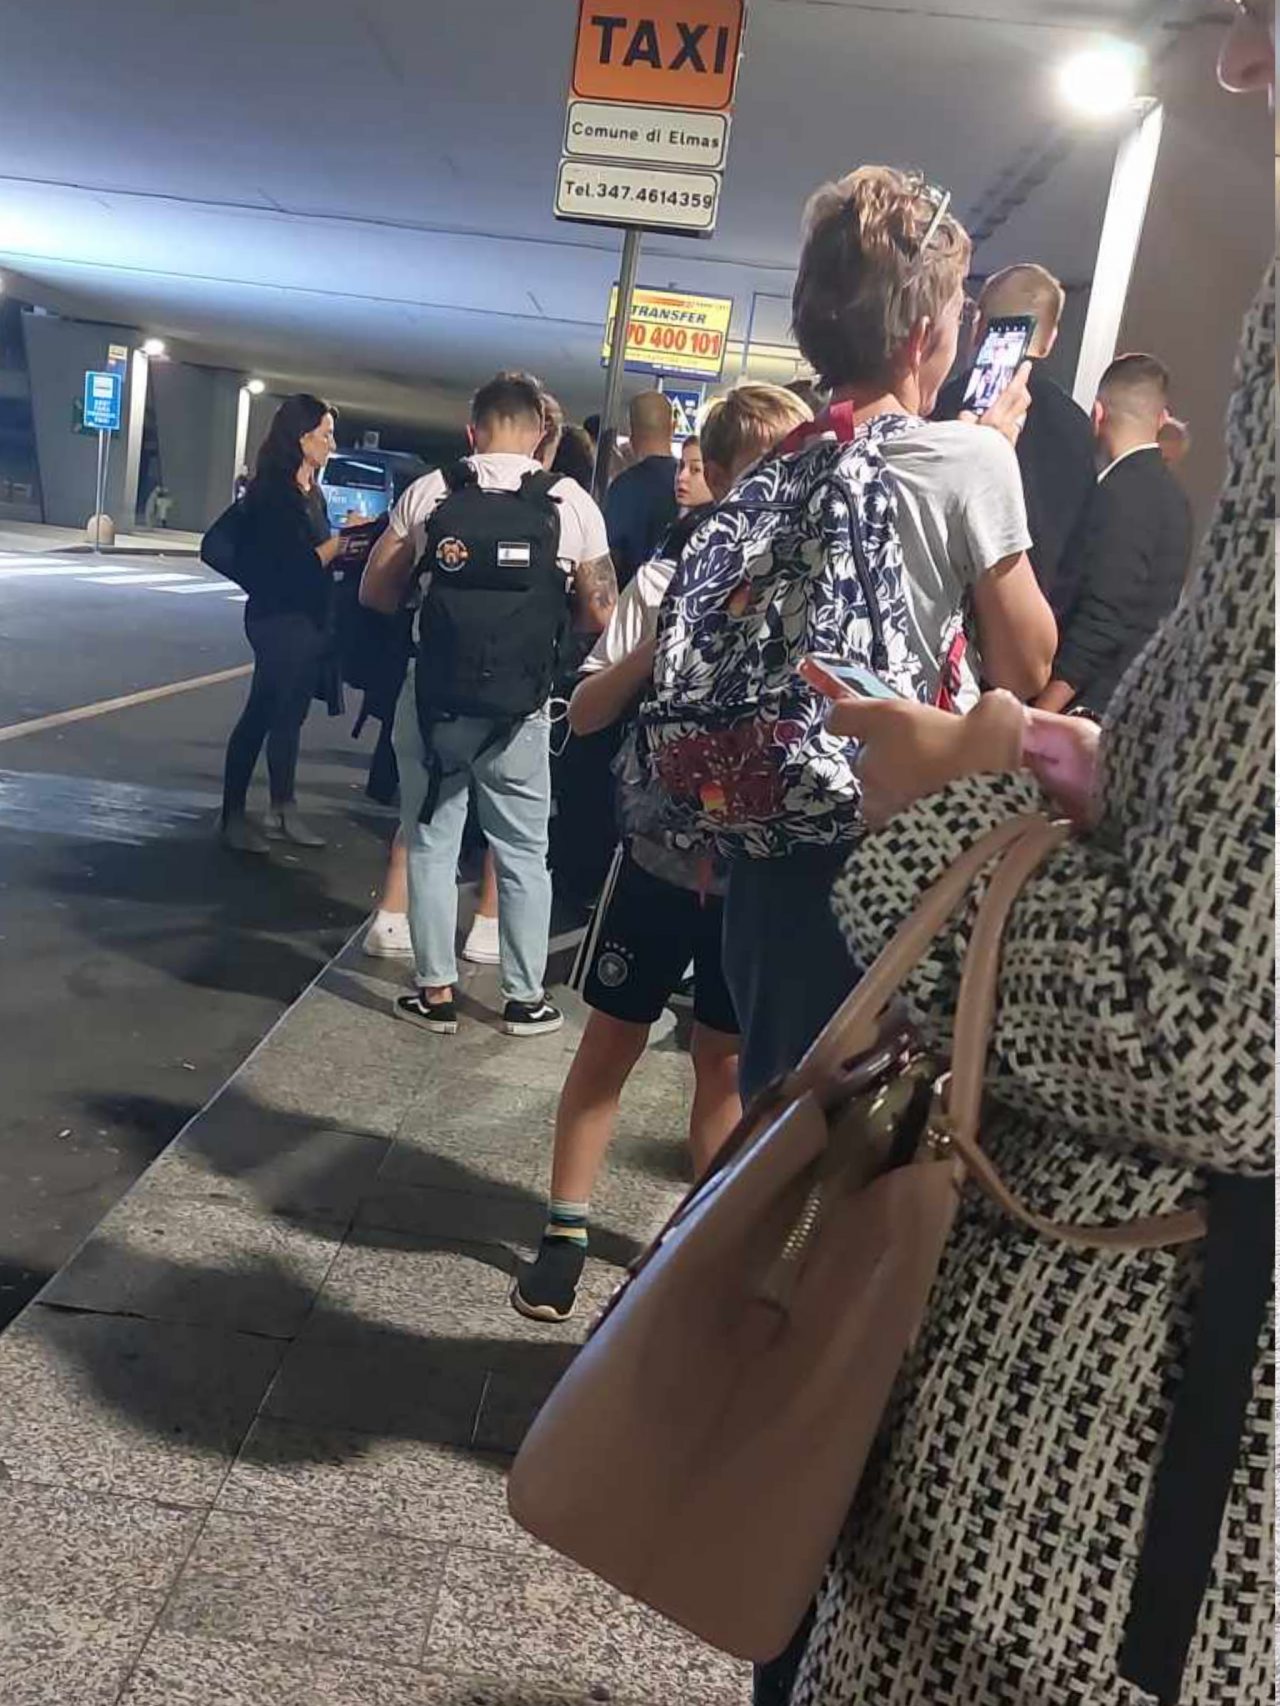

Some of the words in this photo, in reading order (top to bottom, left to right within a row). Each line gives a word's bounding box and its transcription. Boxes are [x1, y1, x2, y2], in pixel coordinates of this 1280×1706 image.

[591, 16, 729, 74] TAXI
[571, 121, 639, 142] Comune
[646, 128, 661, 143] di
[669, 131, 719, 148] Elmas
[564, 180, 713, 210] Tel.347.4614359
[631, 305, 707, 324] TRANSFER
[650, 326, 688, 351] 400
[691, 331, 720, 356] 101
